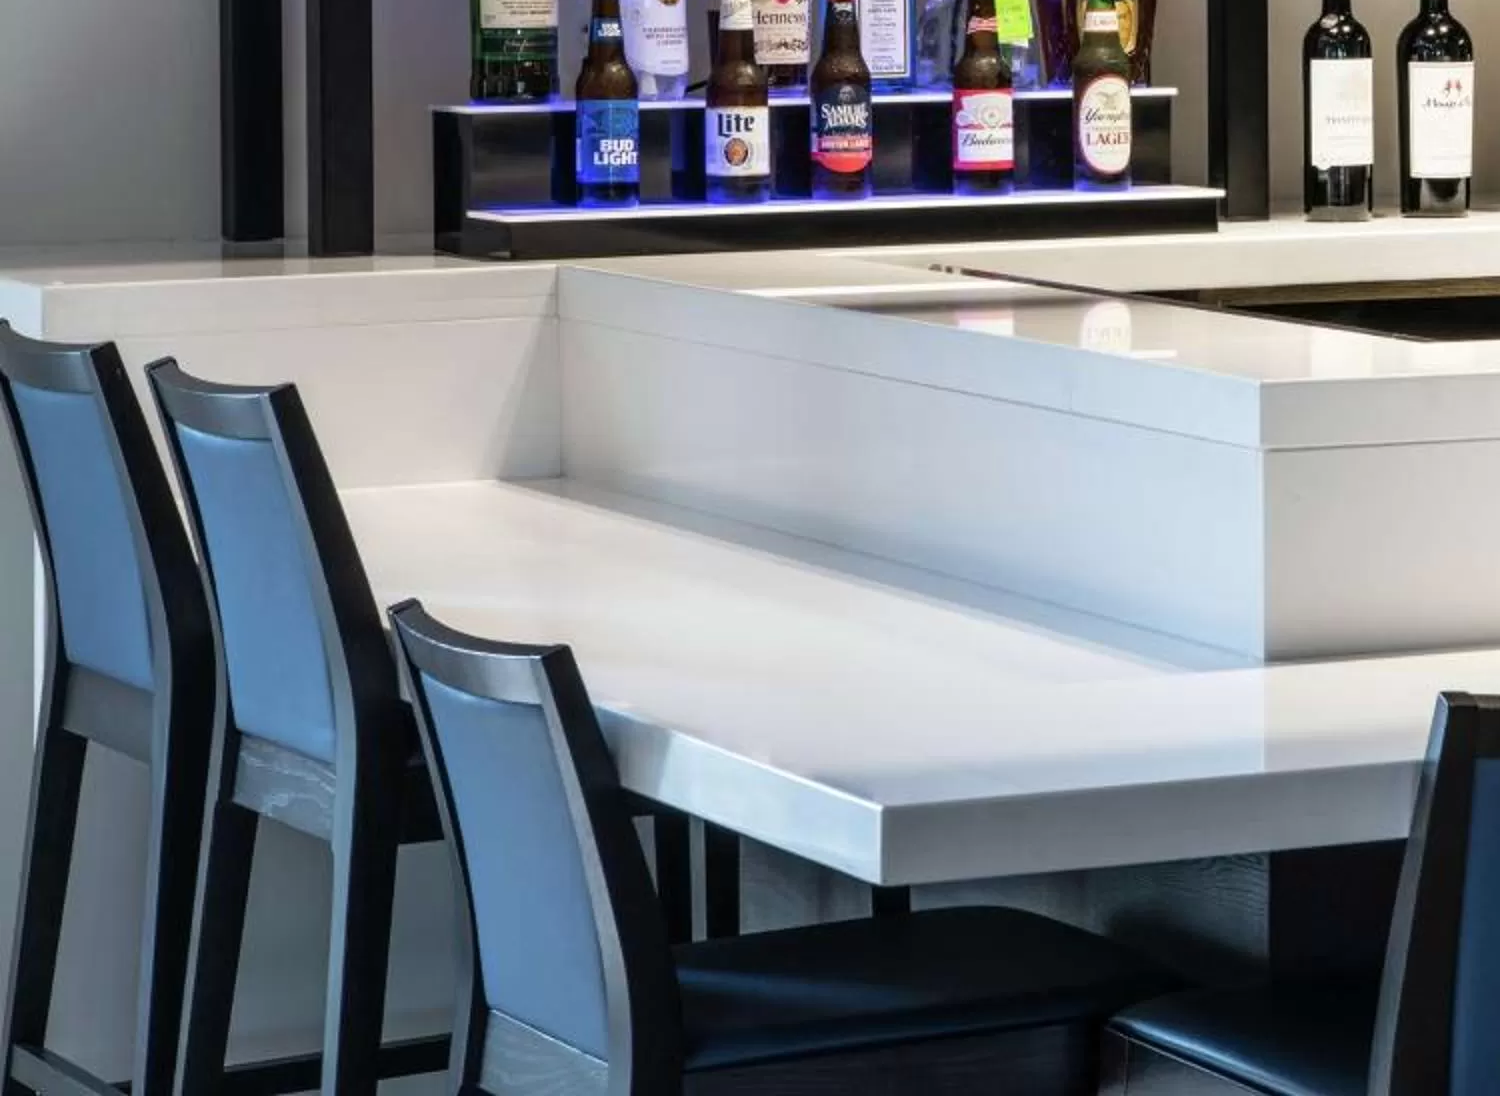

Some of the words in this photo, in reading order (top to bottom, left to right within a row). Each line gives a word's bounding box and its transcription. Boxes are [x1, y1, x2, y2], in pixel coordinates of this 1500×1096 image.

[717, 112, 755, 138] Lite
[600, 139, 634, 153] BUD
[593, 151, 638, 165] LIGHT
